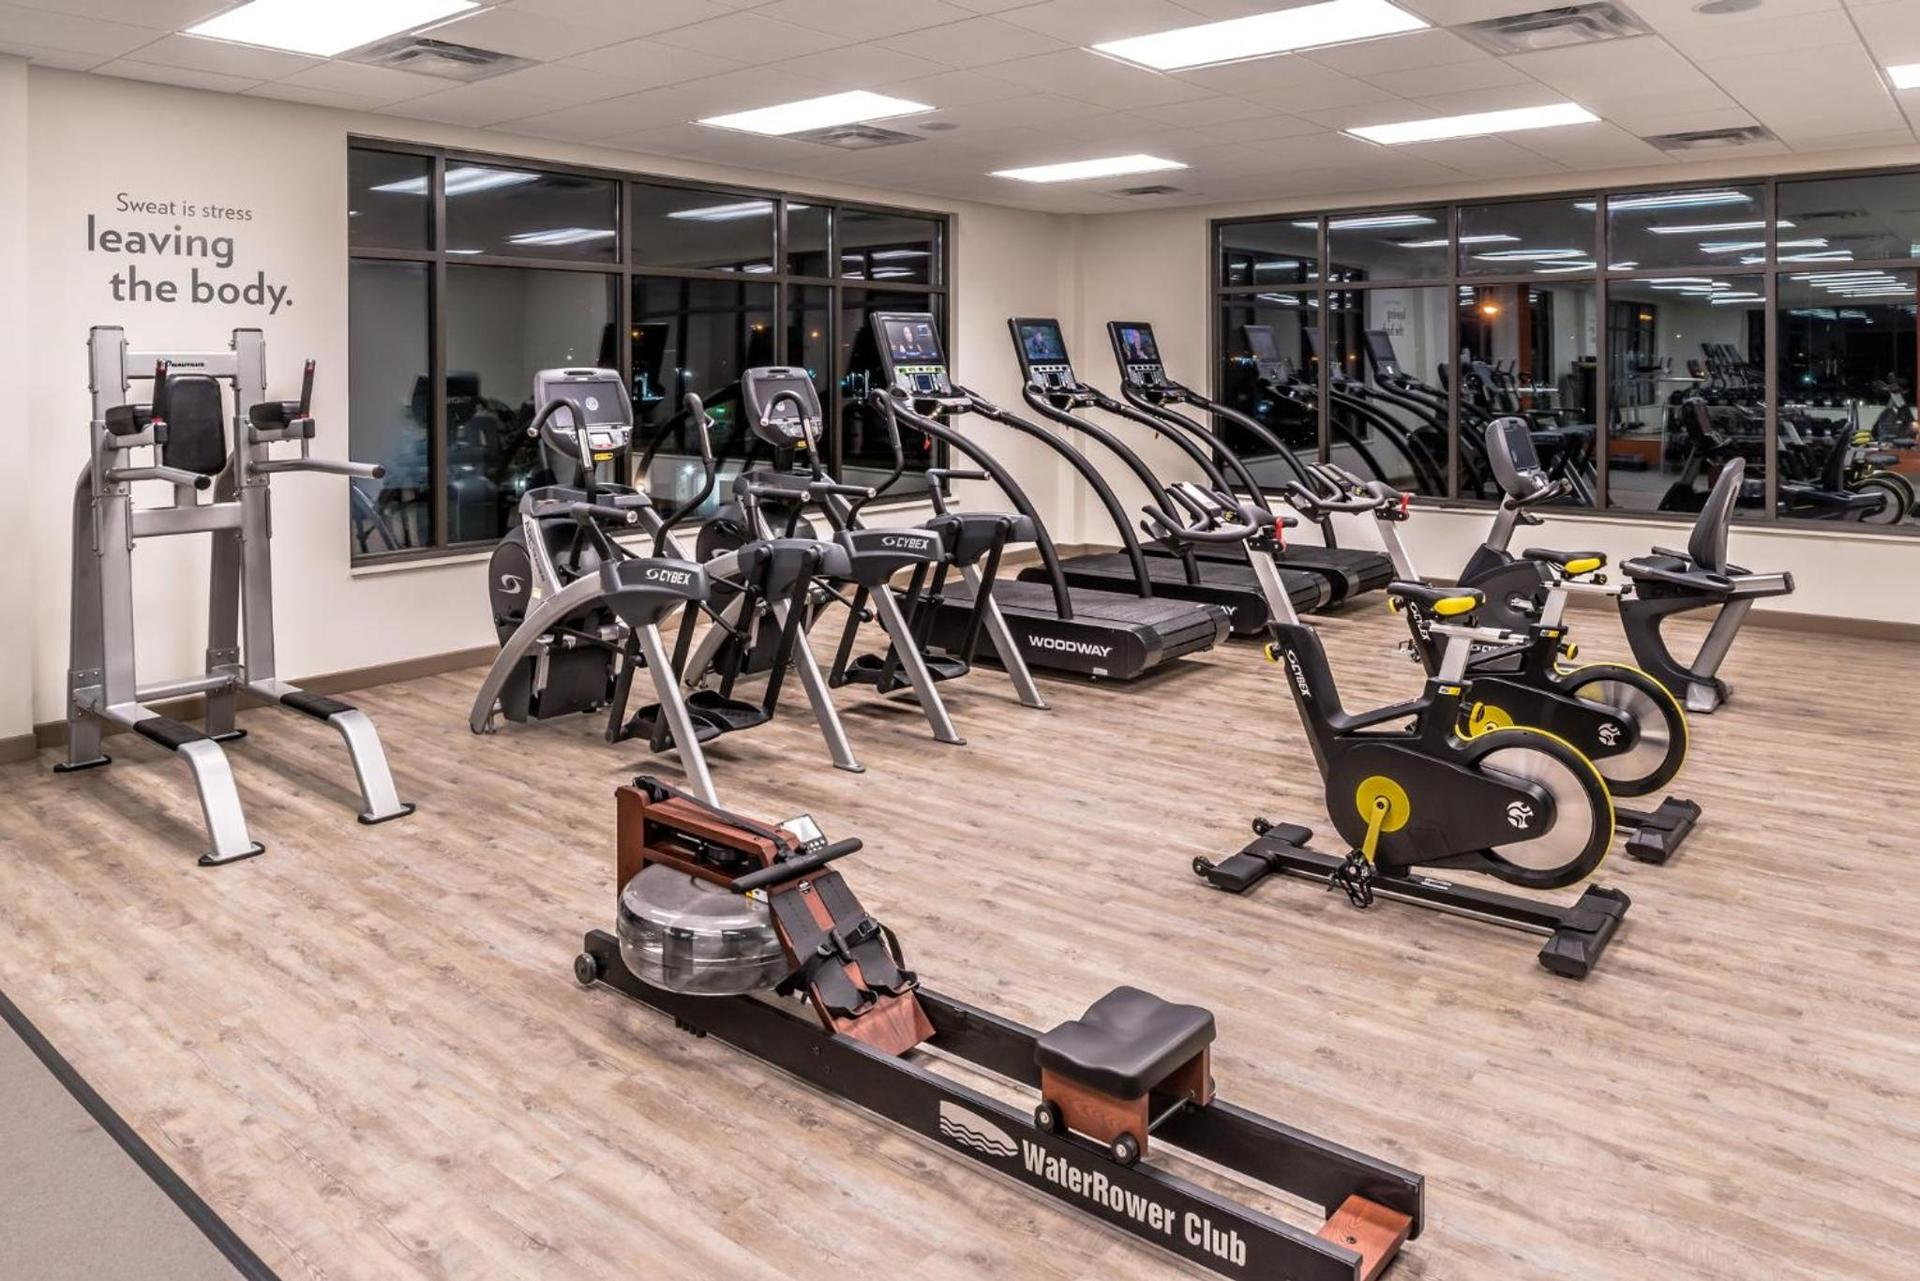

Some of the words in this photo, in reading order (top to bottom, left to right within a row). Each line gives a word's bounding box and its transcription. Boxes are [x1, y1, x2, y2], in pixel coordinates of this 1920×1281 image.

[116, 192, 176, 216] Sweat
[182, 201, 195, 216] is
[202, 204, 253, 221] stress
[87, 213, 234, 269] leaving
[108, 264, 178, 302] the
[191, 267, 293, 315] body.
[896, 536, 929, 550] CYBEX
[659, 568, 692, 585] CYBEX
[1028, 635, 1113, 657] WOODWAY
[1291, 664, 1312, 698] CYBEX
[1022, 1139, 1176, 1235] WaterRower
[1184, 1211, 1247, 1267] Club
